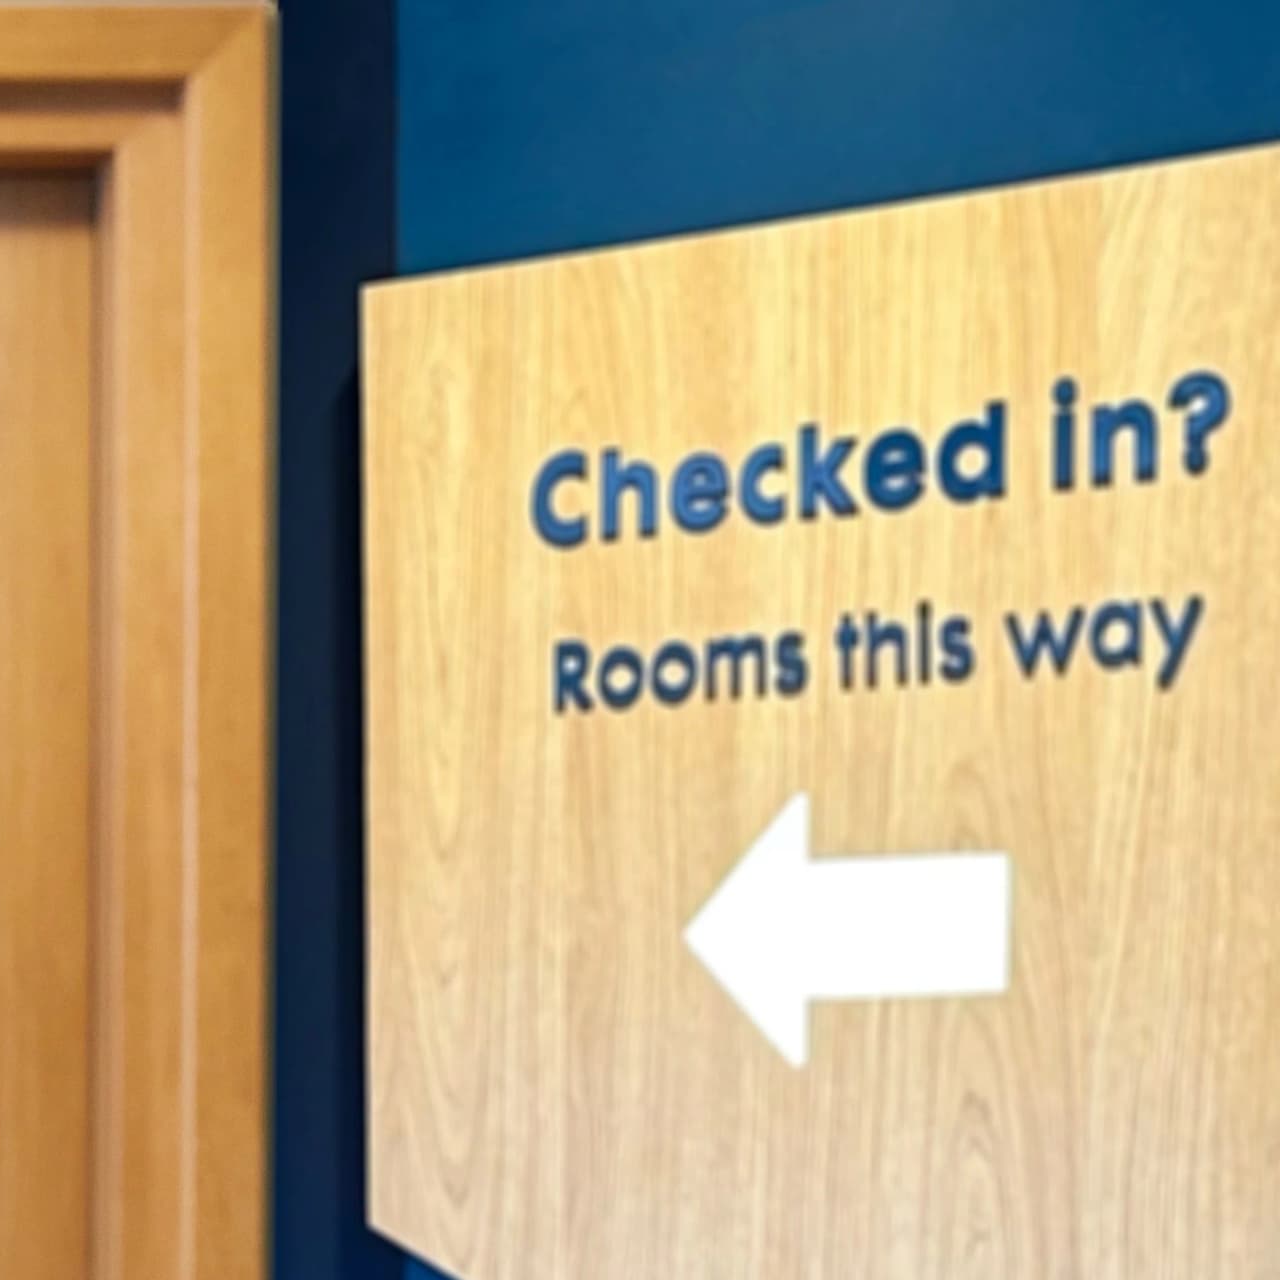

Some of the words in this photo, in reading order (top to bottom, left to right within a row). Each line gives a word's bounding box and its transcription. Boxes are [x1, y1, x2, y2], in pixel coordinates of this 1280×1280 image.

[530, 399, 1007, 549] Checked
[1052, 370, 1231, 492] in?
[553, 630, 808, 716] Rooms
[834, 600, 975, 692] this
[1004, 594, 1205, 692] way
